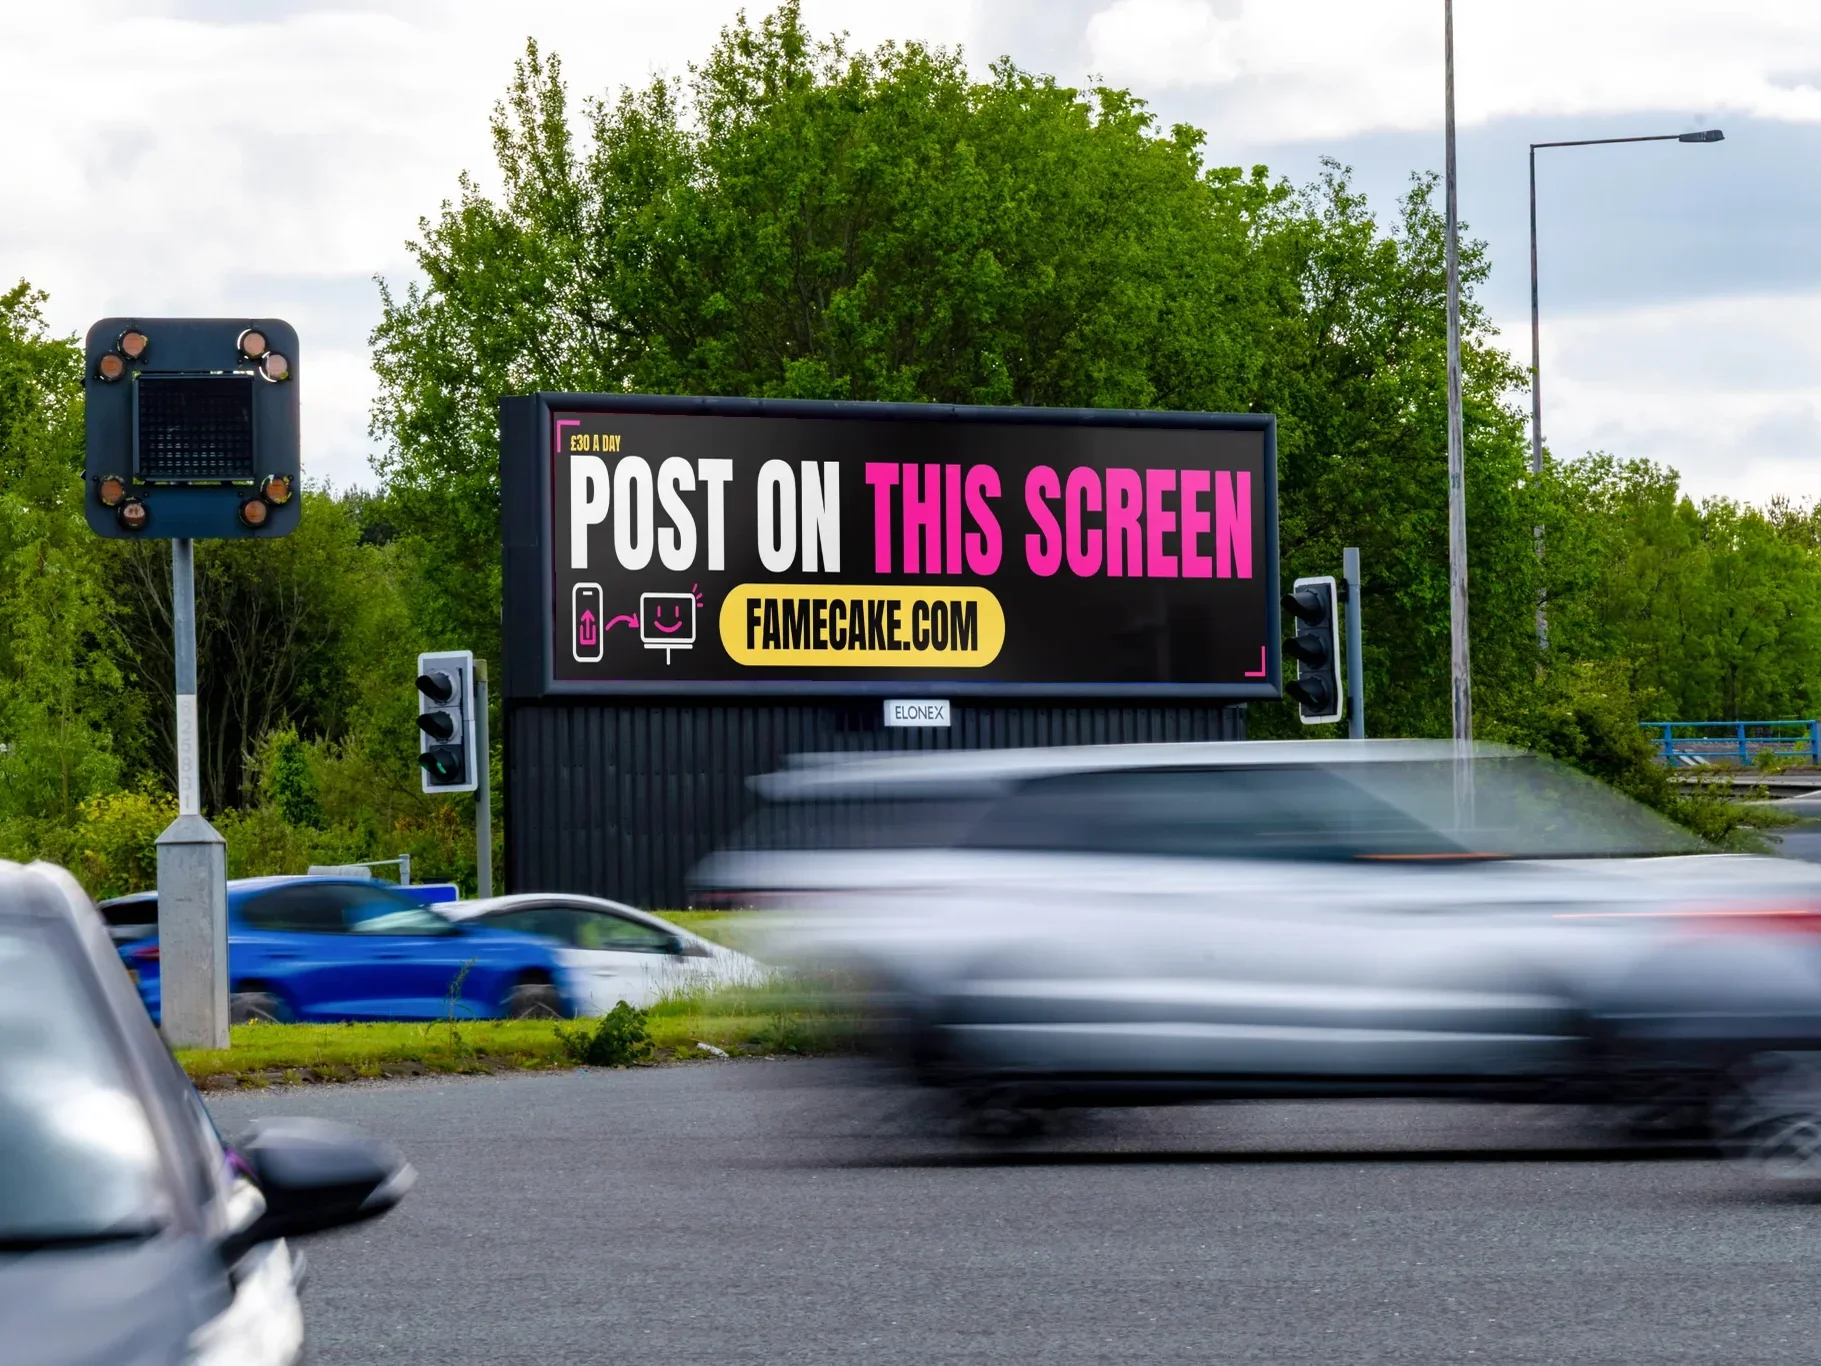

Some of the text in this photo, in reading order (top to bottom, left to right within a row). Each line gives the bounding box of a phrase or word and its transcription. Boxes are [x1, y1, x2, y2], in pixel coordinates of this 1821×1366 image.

[570, 434, 621, 452] £30 A DAY
[570, 455, 1253, 579] POST ON THIS SCREEN
[746, 598, 978, 652] FAMECAKE.COM
[895, 705, 944, 720] ELONEX
